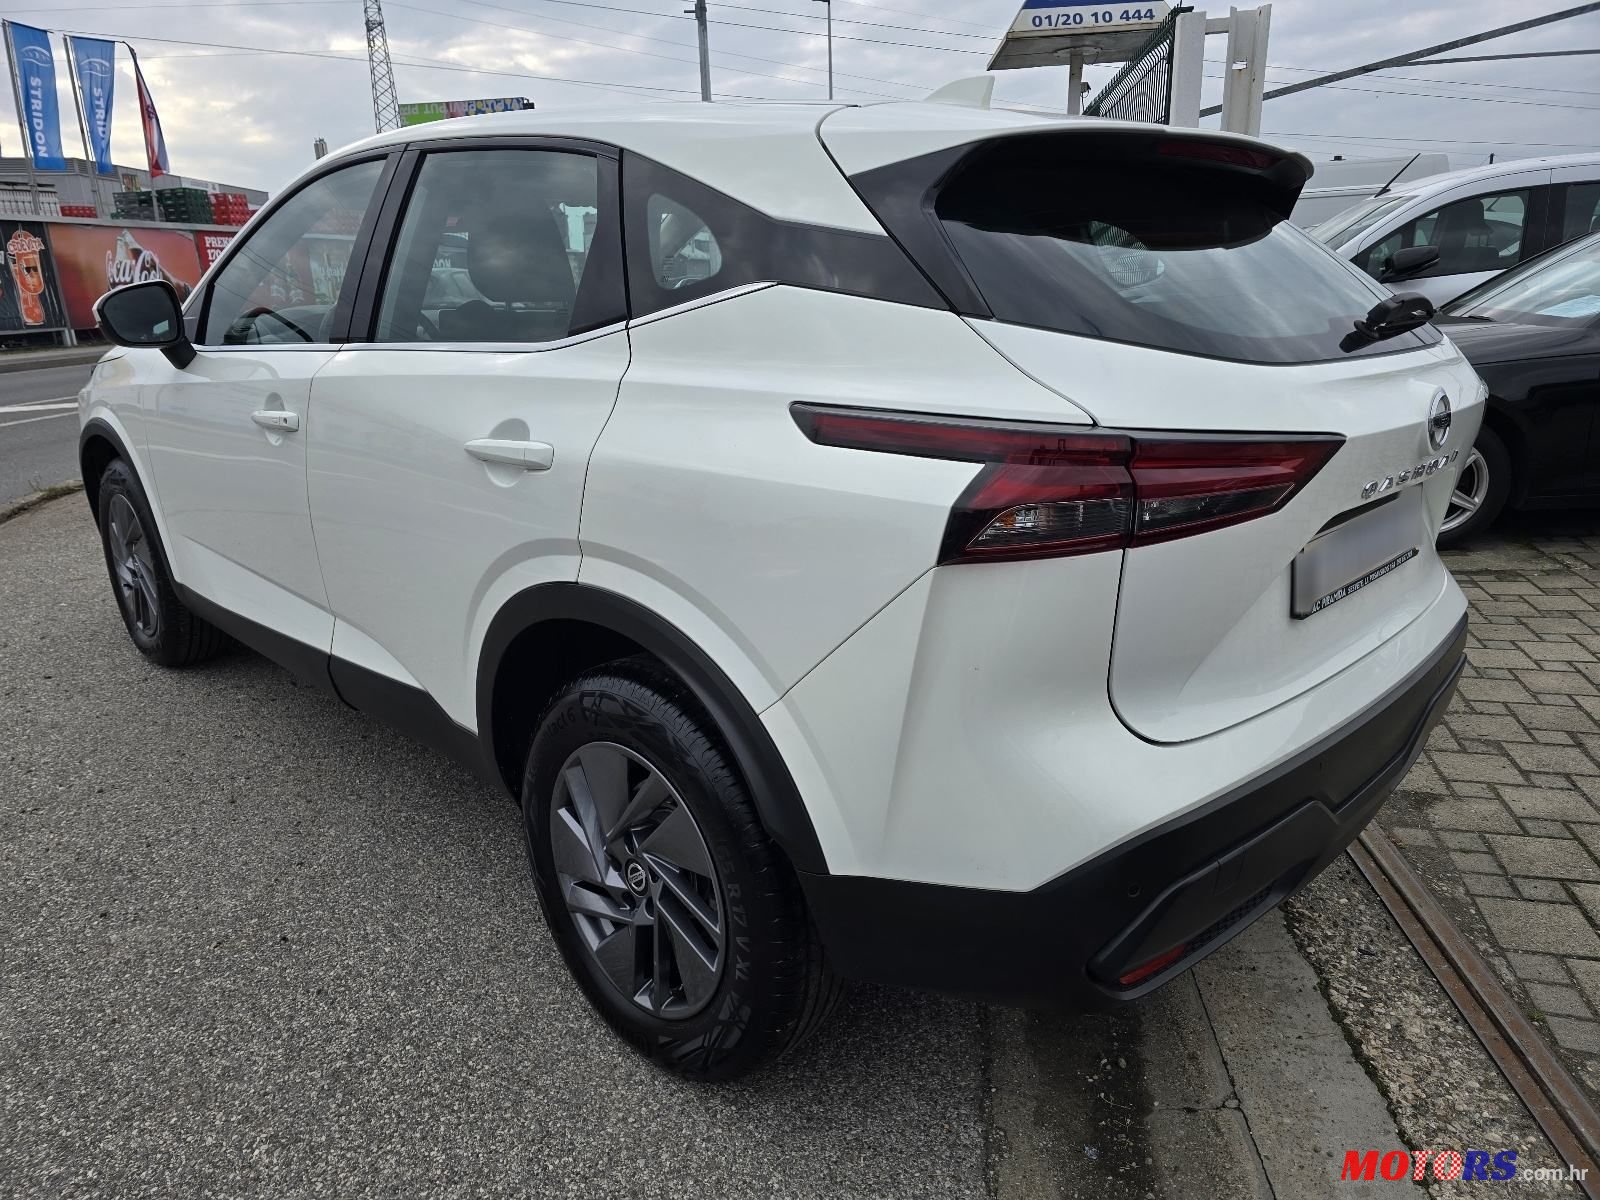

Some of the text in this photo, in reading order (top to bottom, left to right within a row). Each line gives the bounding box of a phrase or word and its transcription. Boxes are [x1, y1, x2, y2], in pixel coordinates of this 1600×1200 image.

[1032, 8, 1155, 28] 01/20 10 444
[30, 76, 49, 158] STRIDON
[93, 87, 107, 140] STRID
[1361, 449, 1459, 499] QASHQAI
[731, 904, 749, 928] 17
